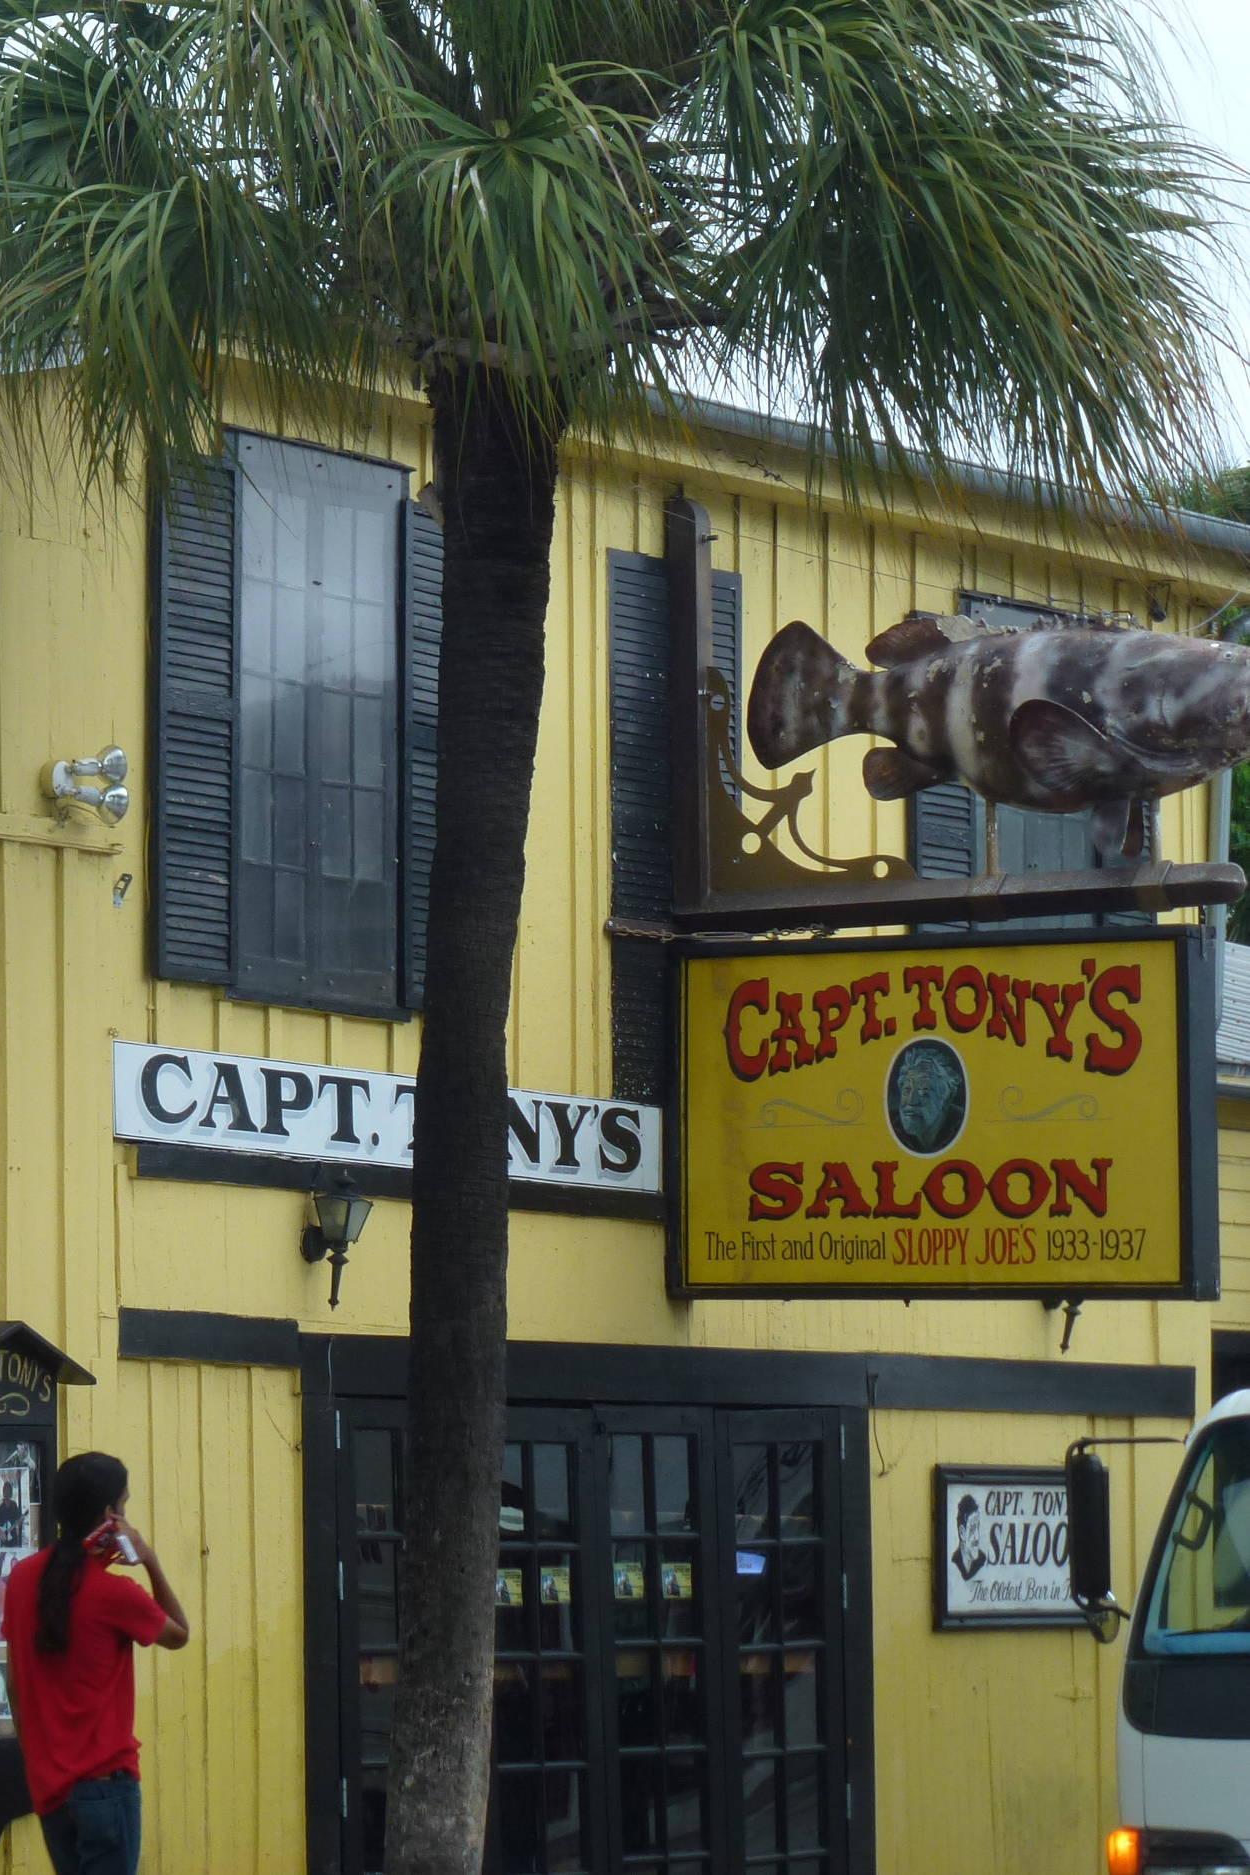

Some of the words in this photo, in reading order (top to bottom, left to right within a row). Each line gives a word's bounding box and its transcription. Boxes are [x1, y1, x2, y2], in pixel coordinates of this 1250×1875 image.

[723, 970, 897, 1082] CAPT.
[902, 958, 1143, 1077] TONY'S
[139, 1053, 381, 1147] CAPT.
[394, 1083, 643, 1174] NY'S
[748, 1157, 1113, 1222] SALOON
[704, 1231, 737, 1261] The
[741, 1231, 777, 1261] First
[781, 1231, 814, 1260] and
[819, 1231, 886, 1265] Original
[893, 1227, 970, 1266] SLOPPY
[975, 1224, 1037, 1265] JOE'S
[1046, 1228, 1147, 1262] 1933-1937
[985, 1490, 1025, 1516] CAPT.
[1031, 1491, 1069, 1516] TON
[986, 1521, 1071, 1568] SALOO
[970, 1580, 989, 1603] The
[990, 1580, 1023, 1602] Oldest
[1023, 1577, 1048, 1602] Bar
[1049, 1581, 1062, 1600] in
